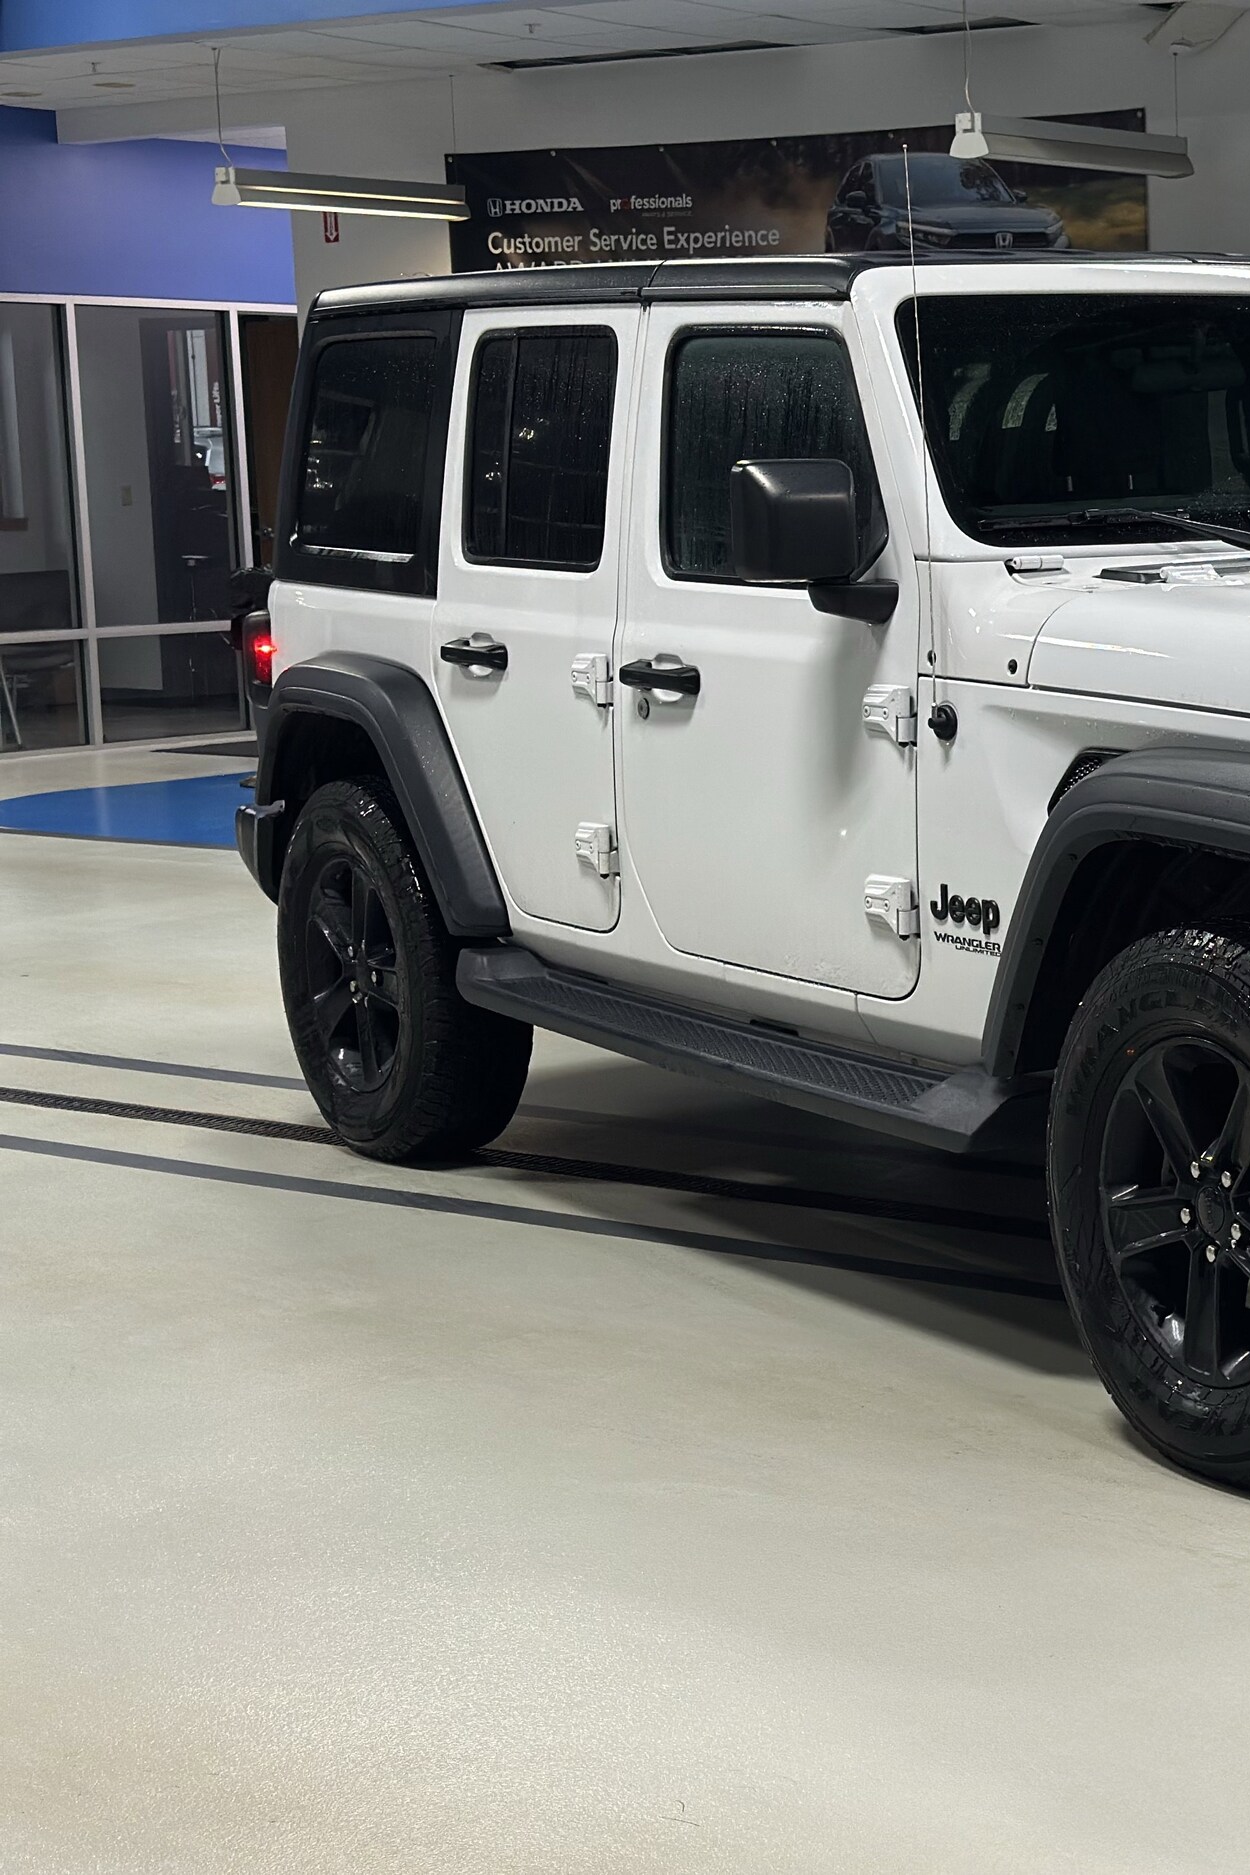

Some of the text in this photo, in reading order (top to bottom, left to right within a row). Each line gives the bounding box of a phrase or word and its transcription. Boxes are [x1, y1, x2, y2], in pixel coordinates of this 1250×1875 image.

[504, 198, 584, 214] HONDA
[487, 225, 780, 255] Customer Service Experience
[930, 884, 1000, 935] Jeep
[934, 931, 1001, 953] WRANGLER
[955, 945, 1002, 957] UNLIMITED
